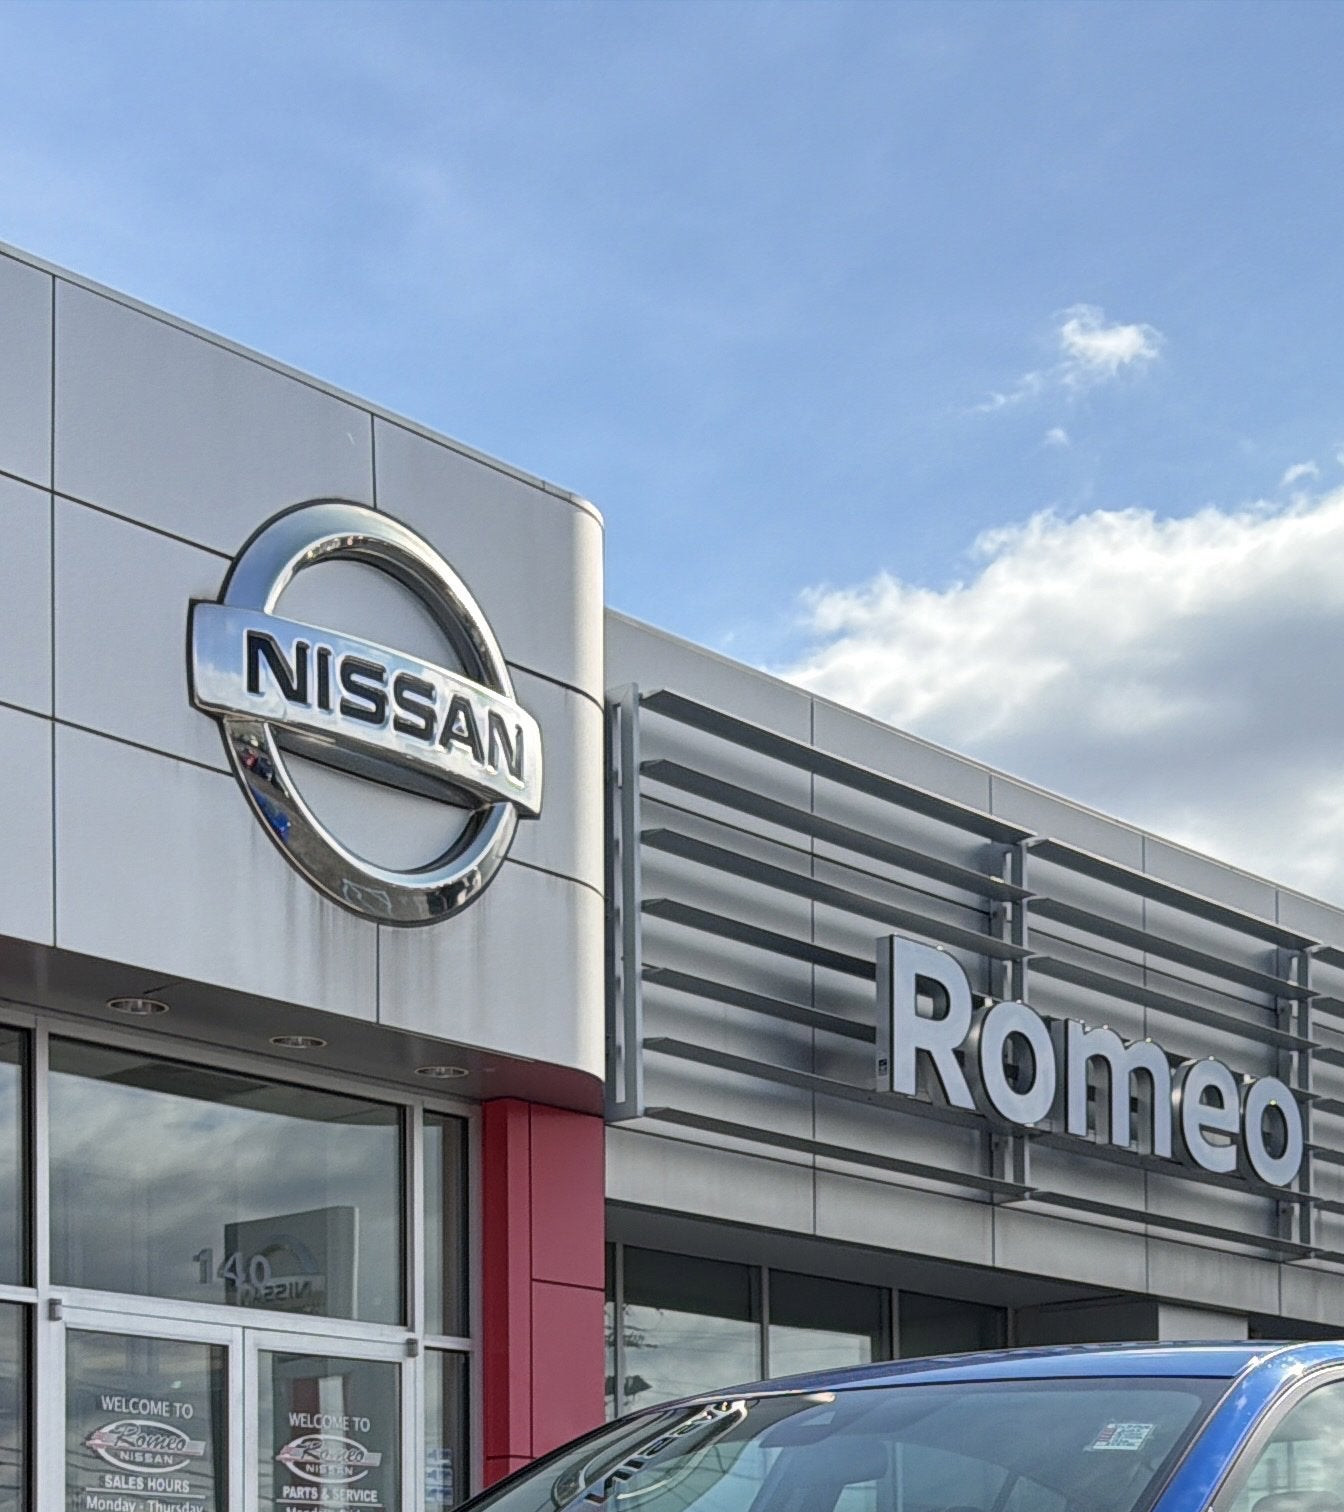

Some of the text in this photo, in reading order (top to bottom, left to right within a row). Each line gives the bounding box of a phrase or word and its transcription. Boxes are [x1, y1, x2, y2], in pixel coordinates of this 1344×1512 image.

[245, 629, 525, 789] NISSAN
[878, 934, 1304, 1187] Romeo
[192, 1247, 272, 1287] 140
[101, 1395, 194, 1419] WELCOME TO
[289, 1412, 371, 1432] WELCOME TO
[110, 1423, 187, 1451] Romeo
[119, 1450, 174, 1465] NISSAN
[305, 1463, 354, 1476] NISSAN
[104, 1475, 190, 1493] SALES HOURS
[282, 1486, 378, 1503] PARTS & SERVICE
